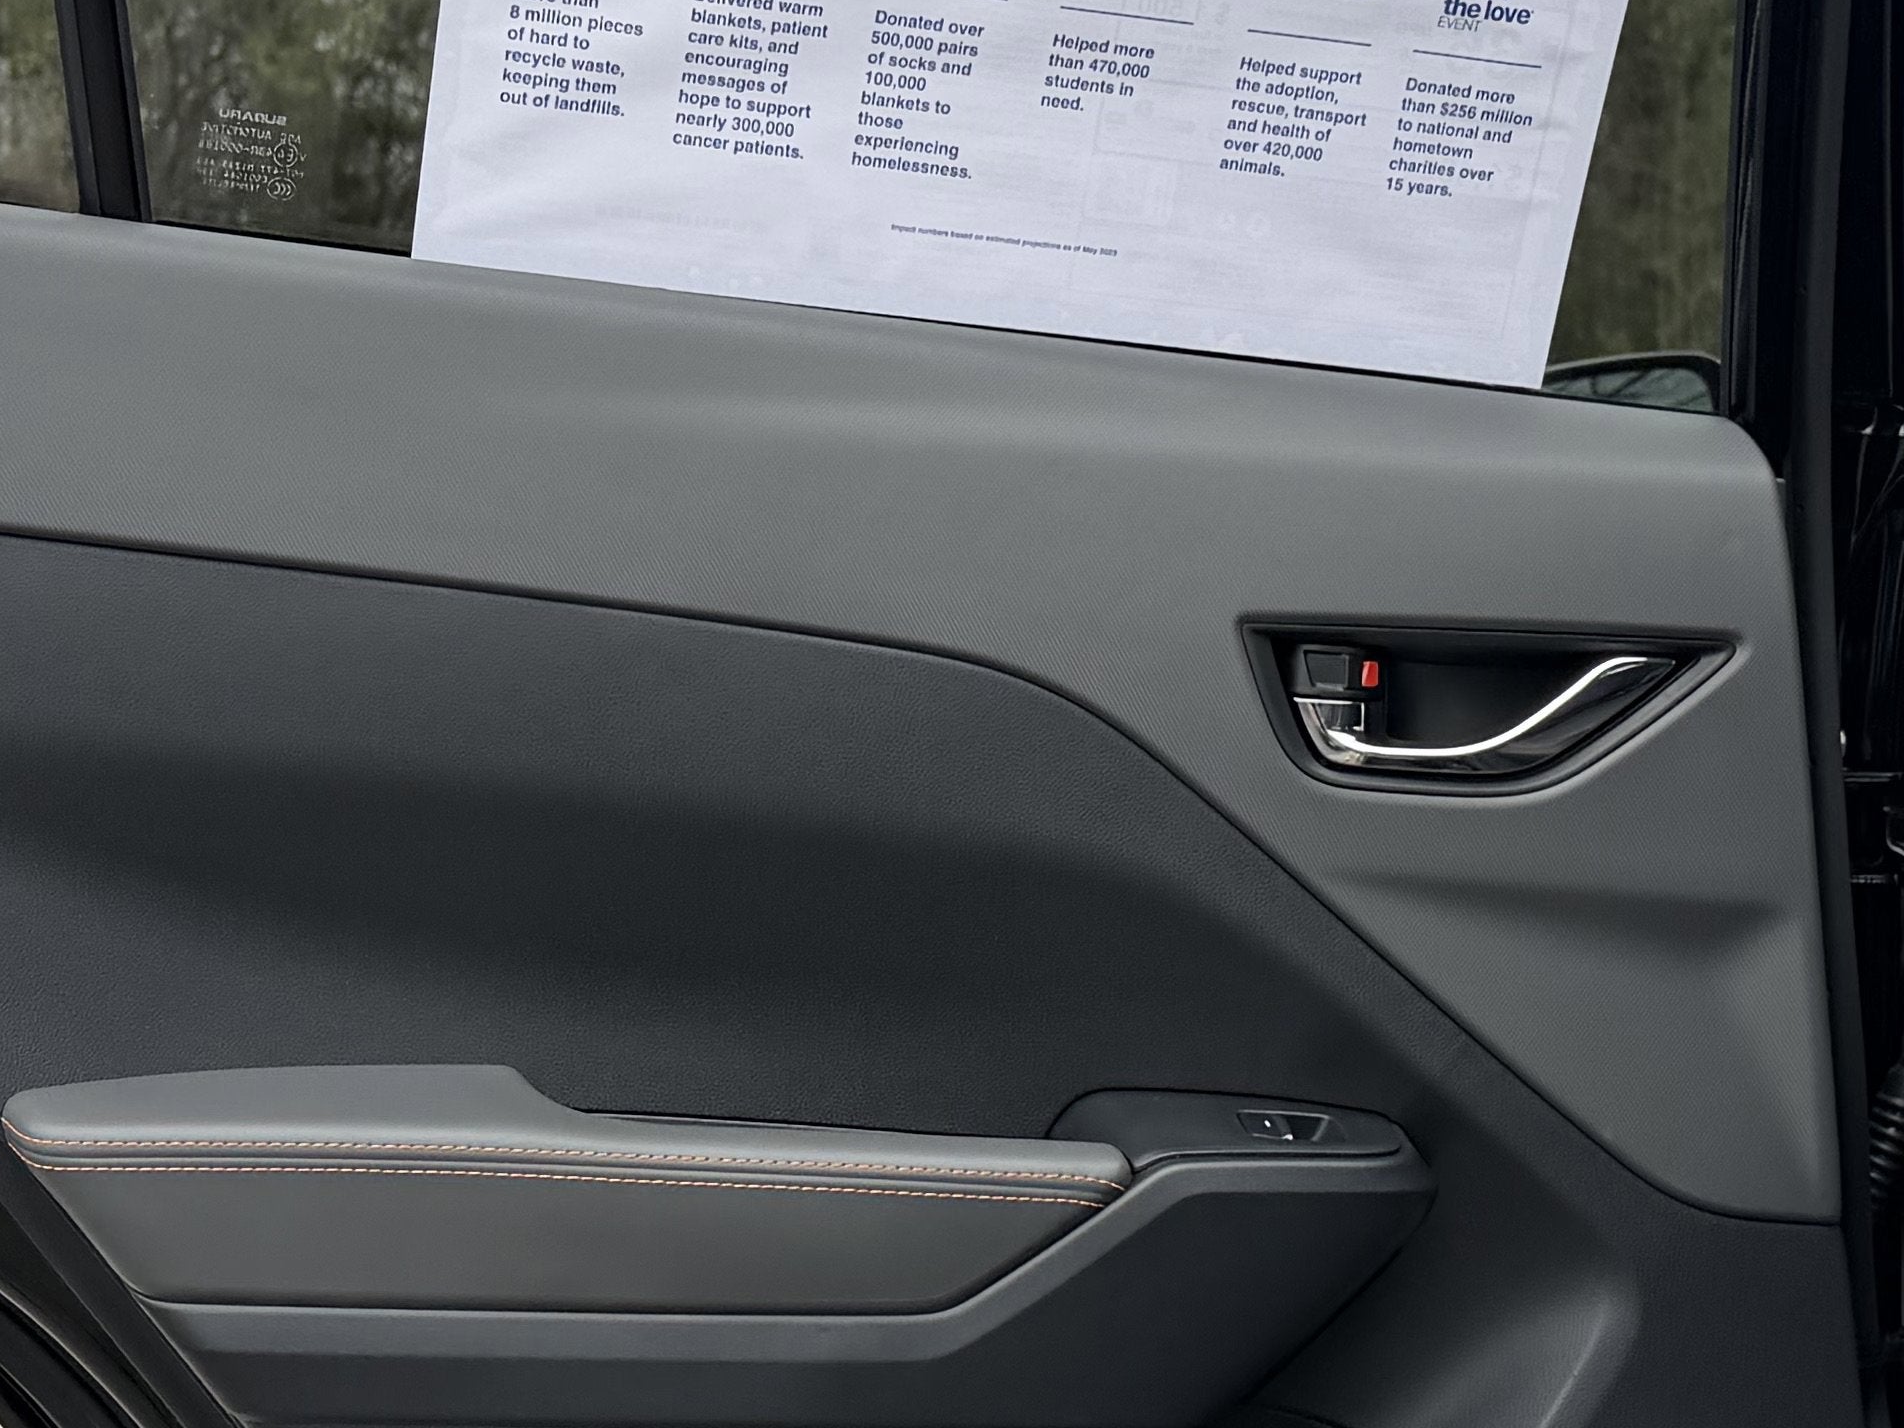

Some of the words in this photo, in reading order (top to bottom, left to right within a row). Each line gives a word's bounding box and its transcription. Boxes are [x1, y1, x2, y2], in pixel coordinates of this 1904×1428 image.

[510, 5, 520, 19] 8
[525, 8, 582, 27] million
[588, 16, 643, 36] pieces
[779, 1, 823, 17] warm
[691, 8, 766, 33] blankets,
[771, 21, 828, 38] patient
[875, 10, 944, 32] Donated
[948, 23, 985, 37] over
[1437, 16, 1482, 32] EVENT
[508, 27, 525, 41] of
[530, 28, 568, 47] hard
[574, 35, 590, 50] to
[688, 32, 724, 46] care
[729, 34, 762, 54] kits,
[768, 41, 799, 55] and
[871, 30, 934, 51] 500,000
[937, 41, 978, 57] pairs
[1053, 34, 1110, 54] Helped
[1113, 44, 1155, 59] more
[505, 50, 566, 68] recycle
[572, 59, 624, 78] waste,
[685, 52, 788, 77] encouraging
[868, 51, 885, 65] of
[888, 56, 936, 72] socks
[941, 62, 972, 76] and
[1049, 53, 1084, 70] than
[1089, 59, 1150, 78] 470,000
[1240, 57, 1296, 77] Helped
[1299, 67, 1362, 85] support
[503, 68, 570, 93] keeping
[575, 77, 616, 93] them
[682, 72, 765, 93] messages
[771, 81, 788, 95] of
[865, 71, 926, 91] 100,000
[1044, 75, 1114, 94] students
[1119, 82, 1134, 97] in
[1236, 77, 1260, 92] the
[1265, 82, 1338, 105] adoption,
[1405, 77, 1472, 98] Donated
[1475, 90, 1515, 104] more
[500, 92, 527, 105] out
[533, 94, 550, 108] of
[554, 95, 624, 116] landfills.
[678, 89, 720, 109] hope
[726, 95, 741, 110] to
[747, 100, 811, 119] support
[861, 90, 930, 112] blankets
[935, 100, 951, 115] to
[1041, 96, 1084, 111] need.
[1232, 99, 1288, 119] rescue,
[1294, 105, 1366, 126] transport
[1402, 98, 1435, 114] than
[1440, 102, 1477, 119] $256
[1480, 108, 1532, 126] million
[676, 113, 727, 132] nearly
[732, 117, 794, 137] 300,000
[858, 111, 903, 129] those
[1227, 119, 1258, 132] and
[1261, 120, 1310, 140] health
[1315, 128, 1332, 142] of
[1398, 118, 1412, 132] to
[1417, 122, 1479, 139] national
[1482, 130, 1513, 143] and
[673, 133, 729, 150] cancer
[733, 140, 803, 159] patients.
[854, 134, 959, 160] experiencing
[1224, 139, 1259, 153] over
[1263, 141, 1323, 161] 420,000
[1393, 137, 1473, 159] hometown
[852, 151, 971, 179] homelessness.
[1219, 158, 1285, 177] animals.
[1389, 157, 1455, 177] charities
[1459, 168, 1494, 181] over
[1387, 177, 1404, 191] 15
[1407, 181, 1452, 197] years.
